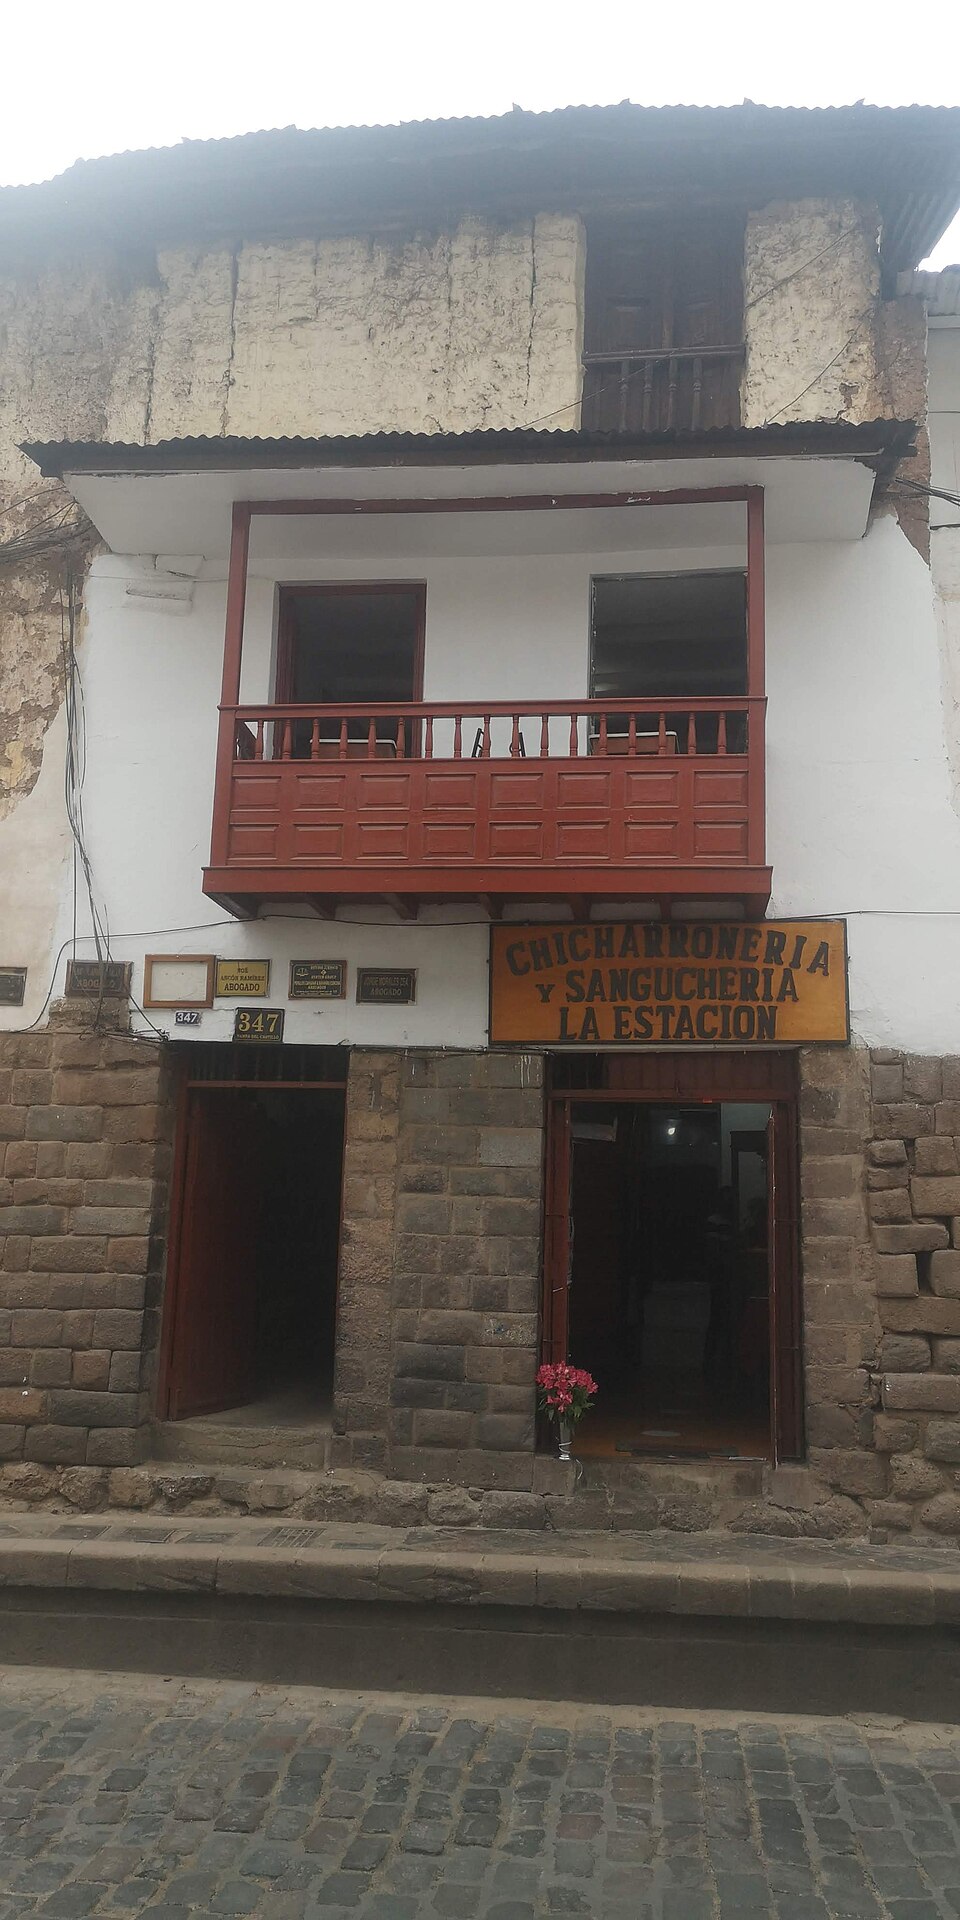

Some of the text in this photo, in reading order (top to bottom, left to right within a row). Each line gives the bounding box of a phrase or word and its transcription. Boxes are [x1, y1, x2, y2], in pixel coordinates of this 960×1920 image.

[506, 924, 831, 977] CHICHARRONERIA
[76, 978, 116, 988] ABOGO
[224, 983, 260, 992] ABOGADO
[535, 967, 800, 1004] Y SANGUCHERIA
[370, 987, 402, 996] ABOGADO
[177, 1012, 198, 1023] 347
[238, 1012, 279, 1033] 347
[558, 1005, 779, 1041] LA ESTACION
